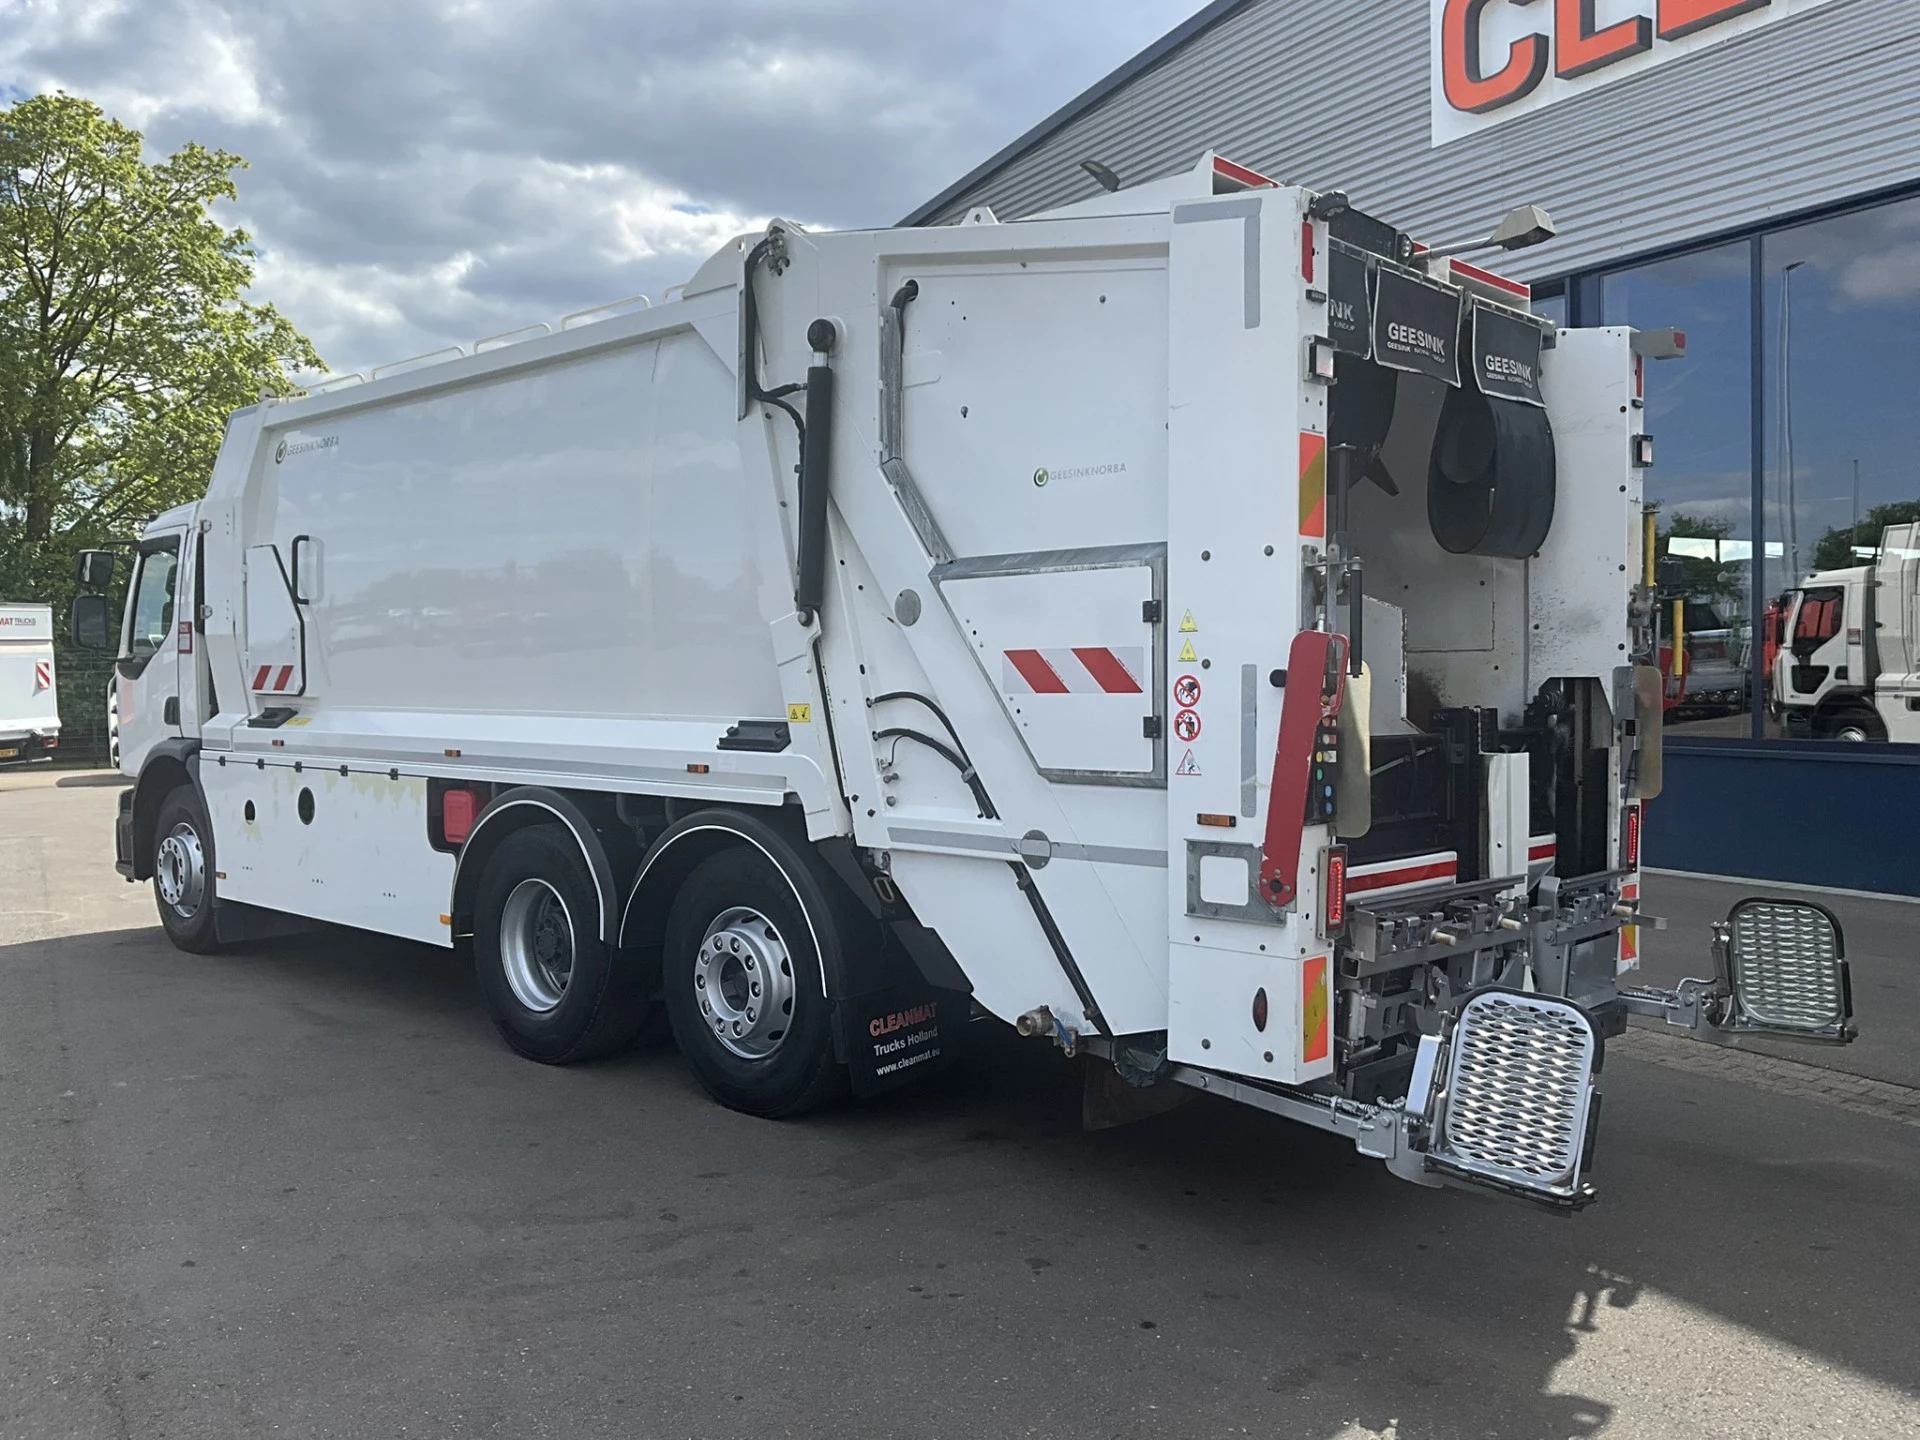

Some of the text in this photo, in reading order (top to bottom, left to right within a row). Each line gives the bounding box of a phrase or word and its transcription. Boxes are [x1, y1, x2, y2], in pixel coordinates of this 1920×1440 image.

[1387, 322, 1445, 356] GEESINK
[1485, 355, 1532, 382] GEESINK
[1049, 462, 1127, 481] GEESINKNORBA
[0, 617, 13, 626] MAT
[869, 1001, 938, 1037] CLEANMAT
[873, 1025, 938, 1056] Trucks Holland
[876, 1048, 941, 1076] www.cleanmat.eu
